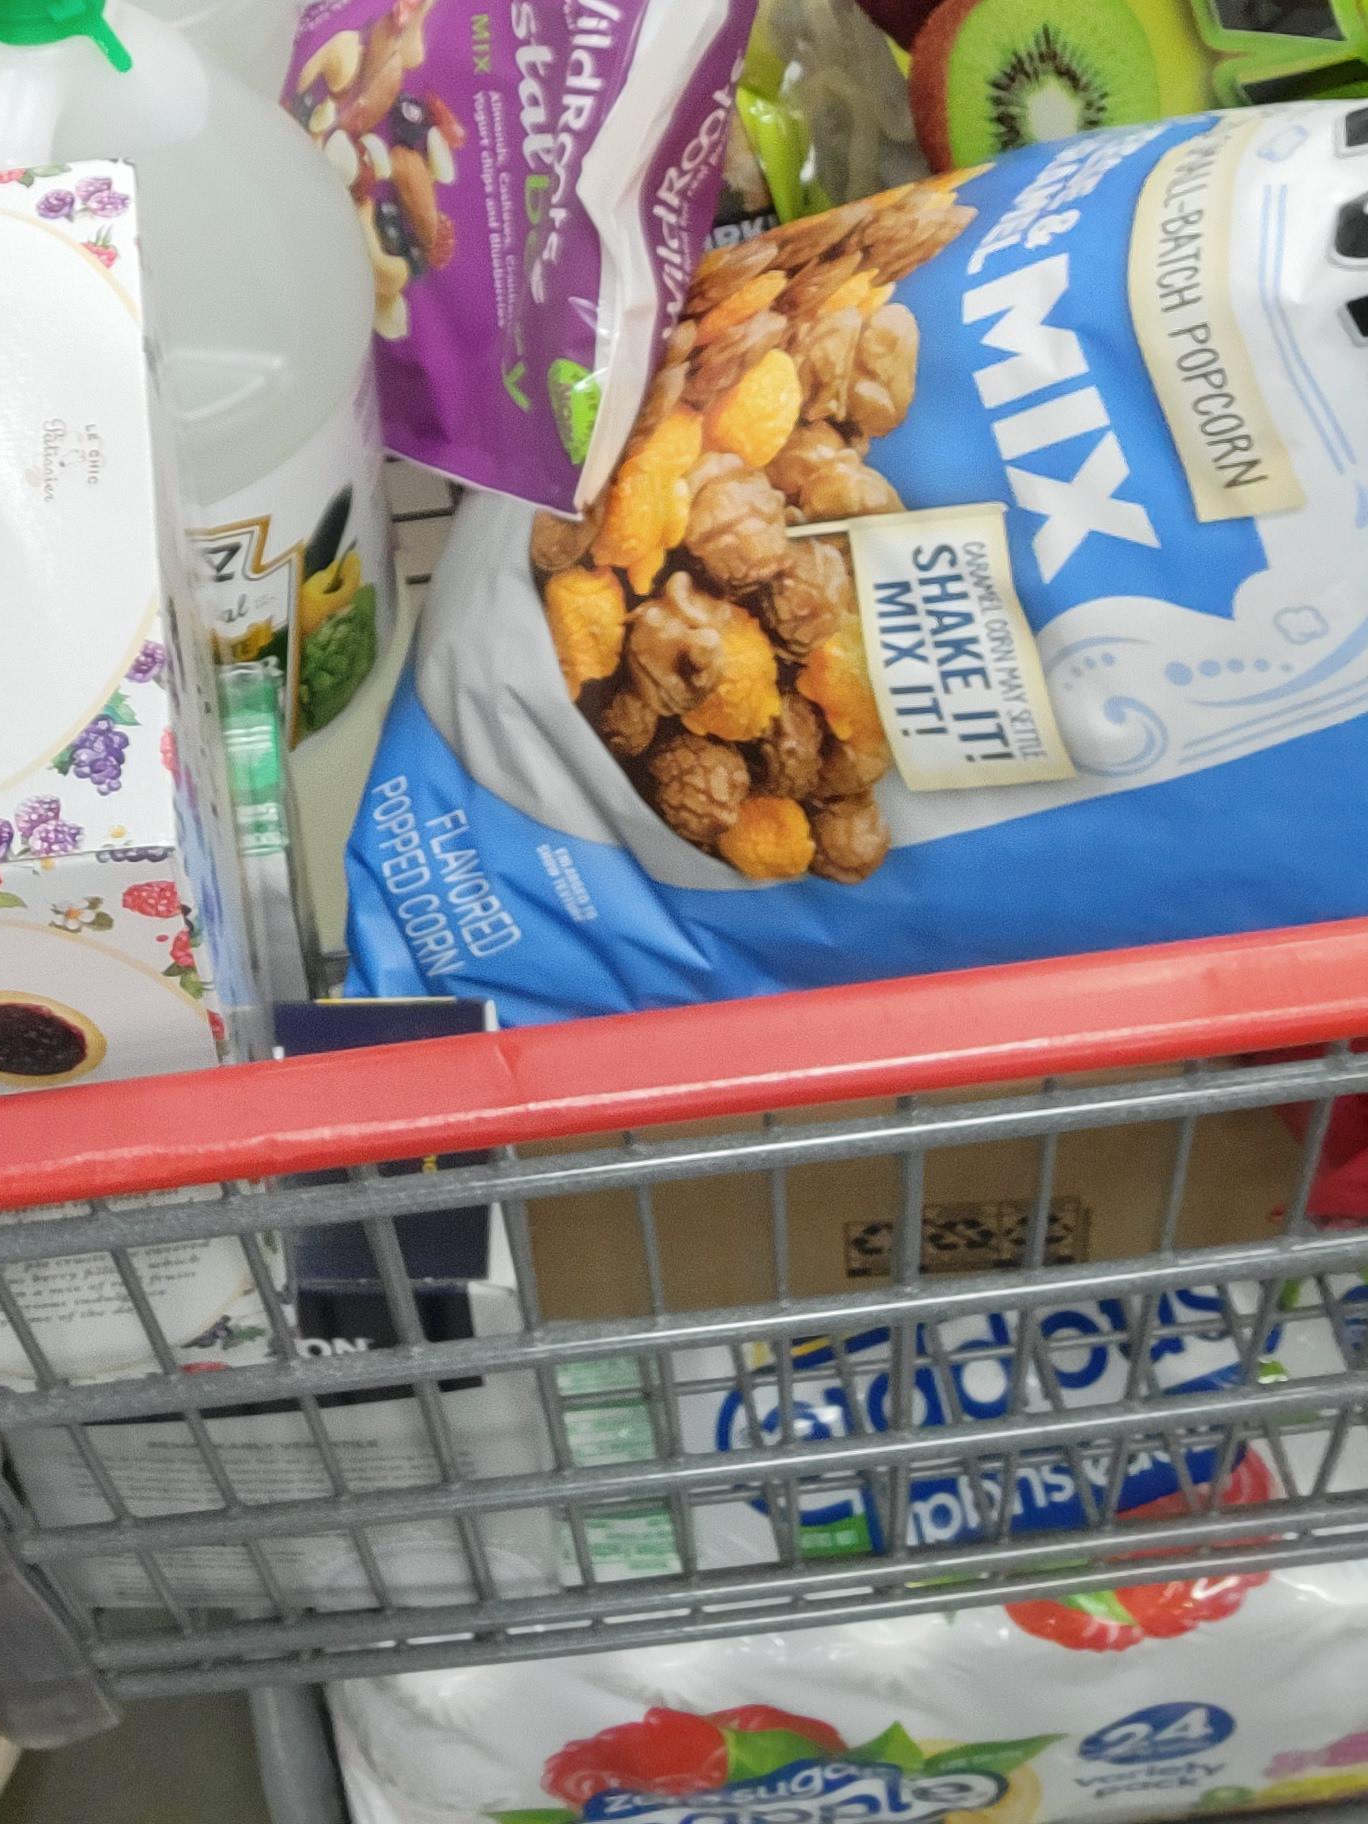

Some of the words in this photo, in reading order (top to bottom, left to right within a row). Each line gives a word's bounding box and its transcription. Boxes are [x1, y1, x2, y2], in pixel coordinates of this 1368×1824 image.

[471, 13, 492, 75] MIX
[960, 253, 1162, 584] MIX
[1168, 319, 1269, 490] POPCORN
[962, 540, 1004, 613] CARAMEL
[873, 580, 930, 669] MIX
[912, 543, 992, 695] SHAKE
[984, 618, 1017, 663] CORN
[888, 684, 949, 737] IT!
[994, 666, 1029, 704] MAY
[951, 709, 1016, 763] IT!
[1008, 708, 1047, 761] SETTLE
[371, 775, 433, 895] POPPED
[403, 893, 466, 978] CORN
[426, 809, 522, 959] FLAVORED
[1099, 1707, 1215, 1760] 24
